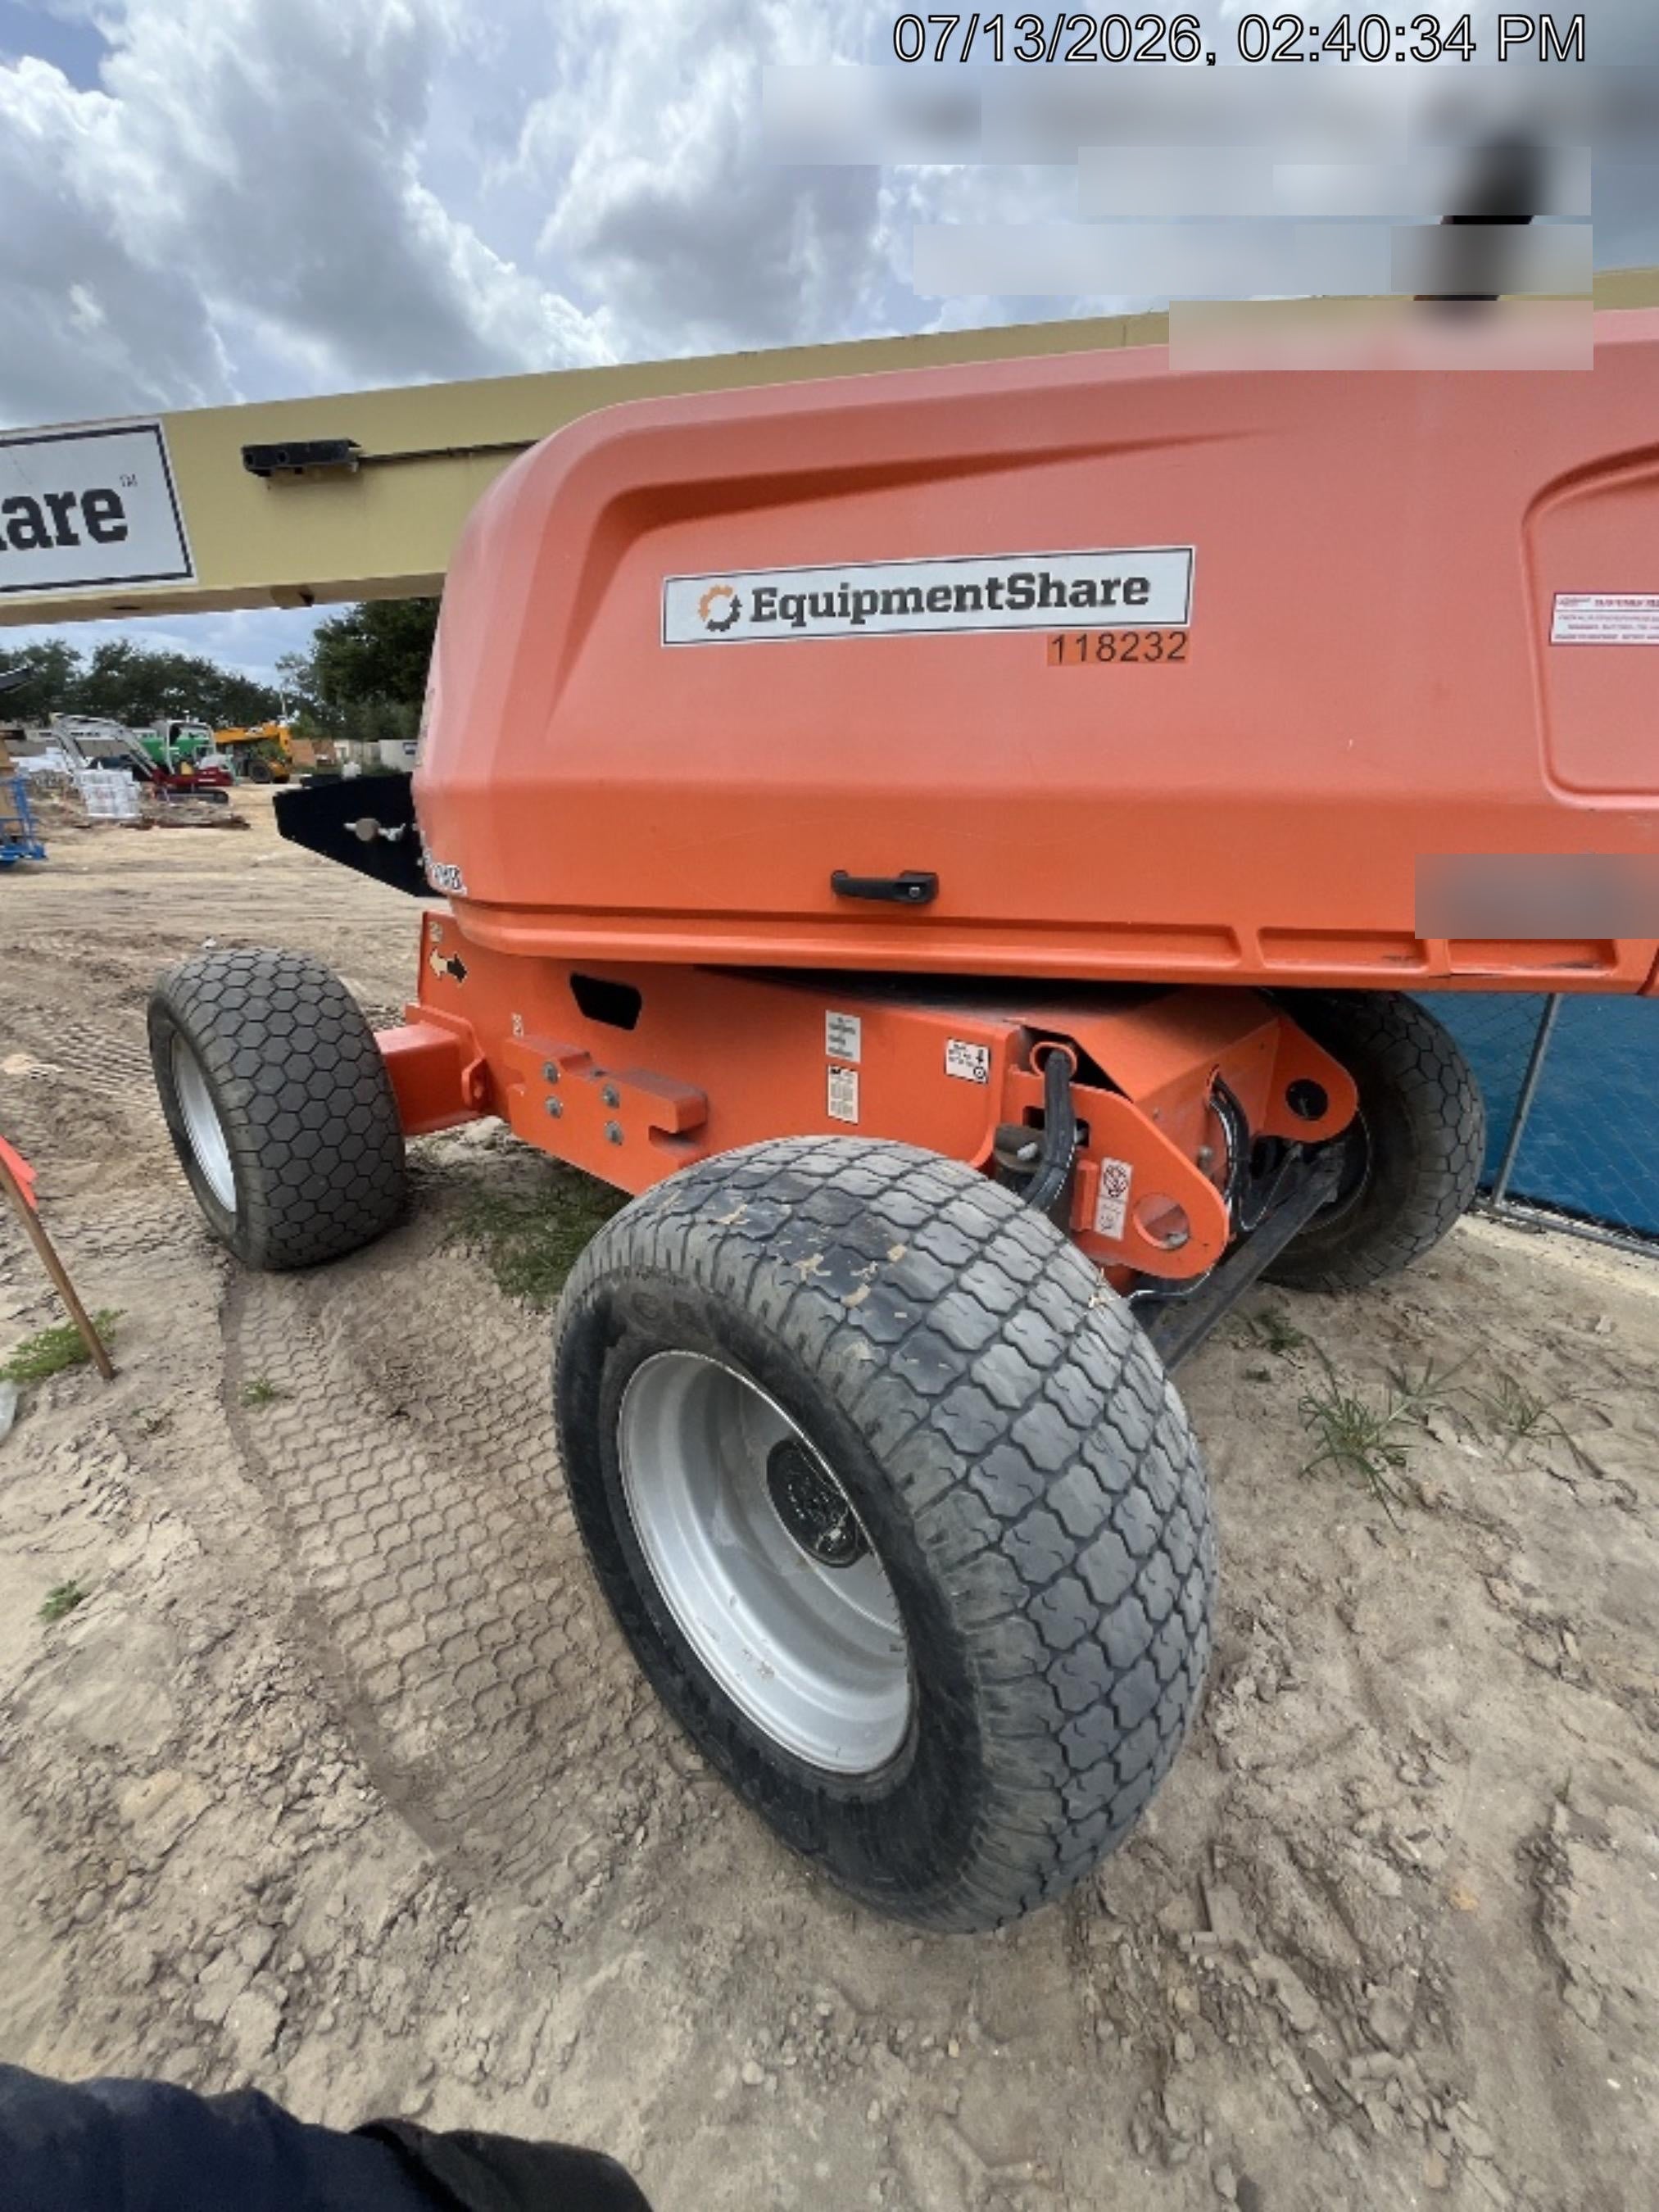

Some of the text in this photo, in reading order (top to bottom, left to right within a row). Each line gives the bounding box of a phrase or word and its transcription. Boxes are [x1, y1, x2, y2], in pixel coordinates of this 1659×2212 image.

[0, 487, 129, 551] are
[750, 571, 1151, 628] EquipmentShare
[1051, 631, 1187, 665] 118232
